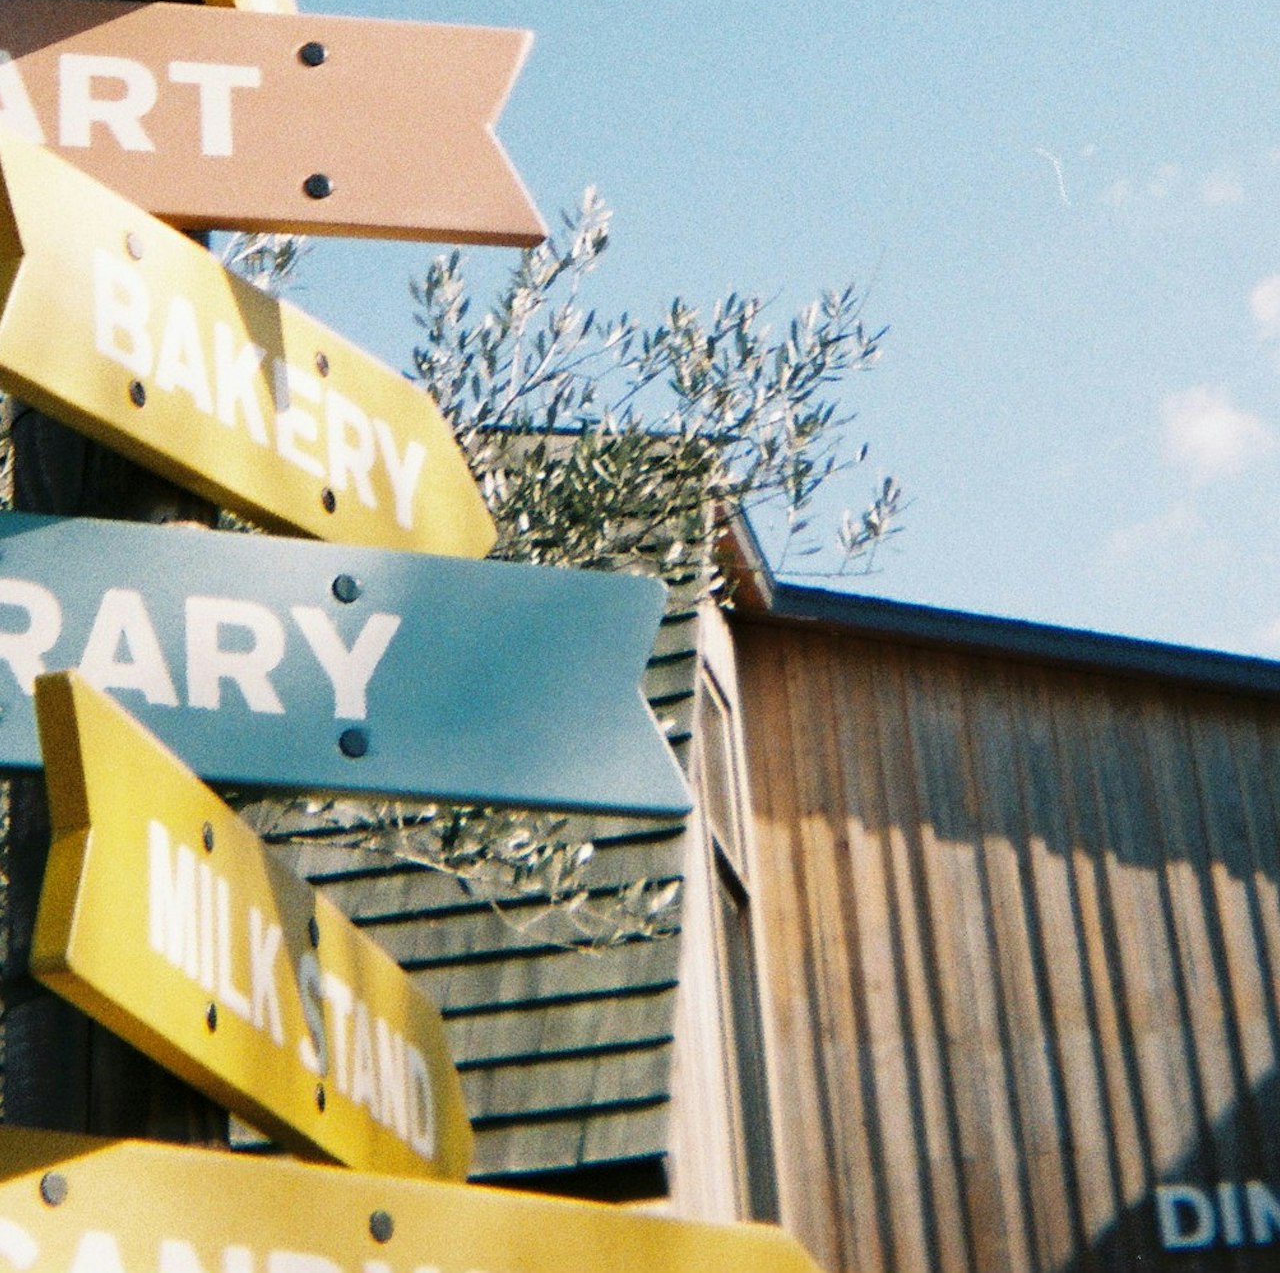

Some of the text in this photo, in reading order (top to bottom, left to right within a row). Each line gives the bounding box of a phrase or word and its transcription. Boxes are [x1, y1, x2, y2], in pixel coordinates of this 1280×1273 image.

[88, 250, 429, 530] BAKERY
[147, 819, 436, 1160] MILK STAND
